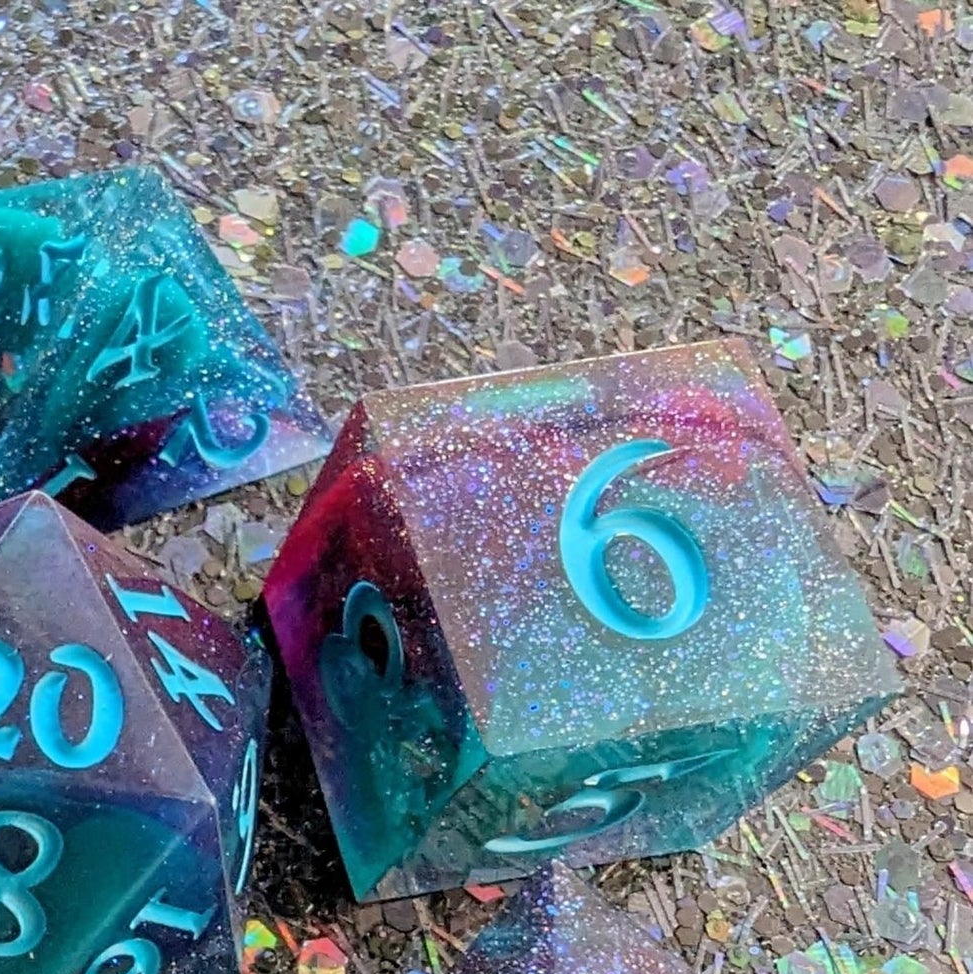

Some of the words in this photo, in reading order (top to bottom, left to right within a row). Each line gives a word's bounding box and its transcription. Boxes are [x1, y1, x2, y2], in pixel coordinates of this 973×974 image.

[86, 271, 196, 389] 4
[560, 438, 710, 640] 6
[107, 573, 235, 732] 14
